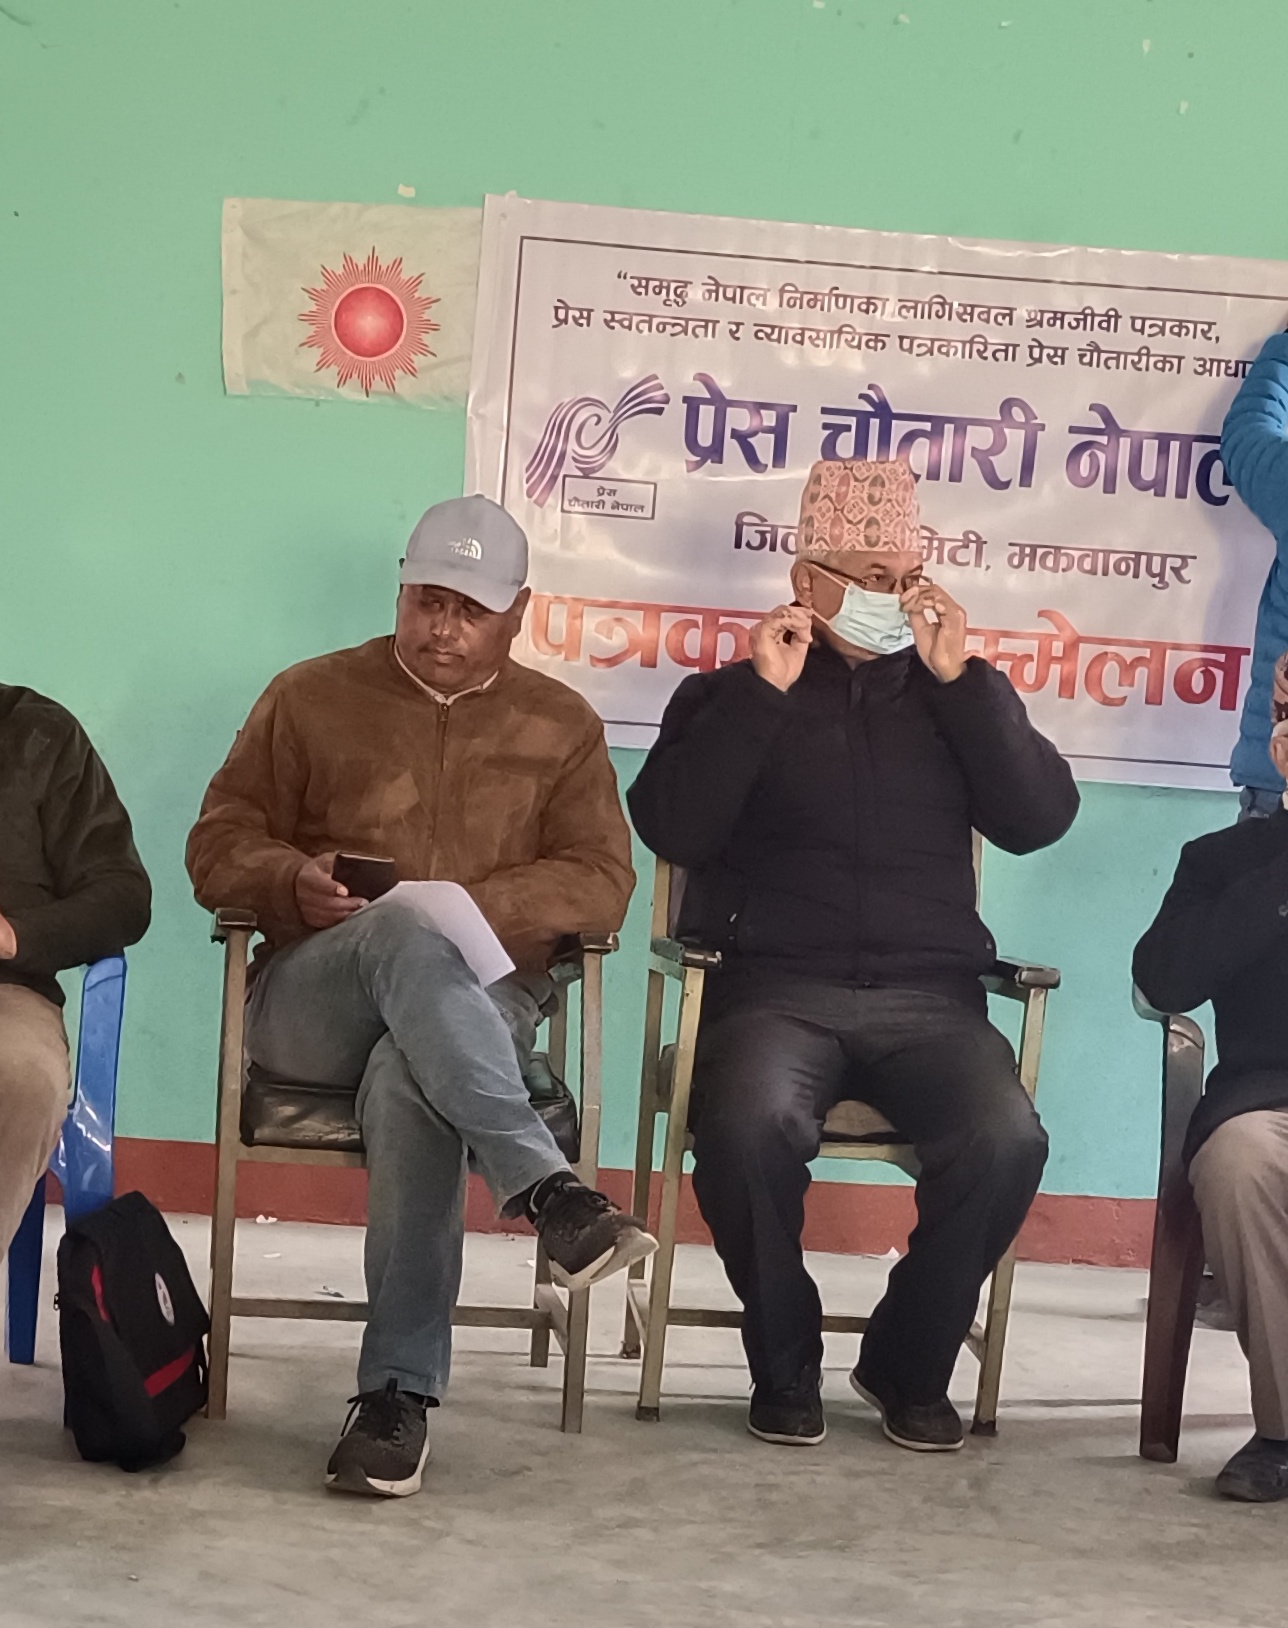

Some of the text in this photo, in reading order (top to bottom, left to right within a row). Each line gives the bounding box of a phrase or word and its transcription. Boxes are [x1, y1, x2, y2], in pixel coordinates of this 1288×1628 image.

[552, 299, 1254, 379] प्रेस स्वतन्त्रता र व्यावसायिक पत्रकारिता प्रेस चौतारीका आधा
[701, 275, 771, 307] नेपाल
[778, 282, 889, 317] निर्माणका
[1025, 305, 1122, 334] श्रमजीवी
[1130, 315, 1220, 344] पत्रकार,
[682, 372, 798, 474] प्रेस
[820, 383, 1046, 491] चौतारी
[596, 484, 618, 497] प्रेस
[919, 524, 991, 572] मिटी,
[1006, 541, 1198, 590] मकवानपुर
